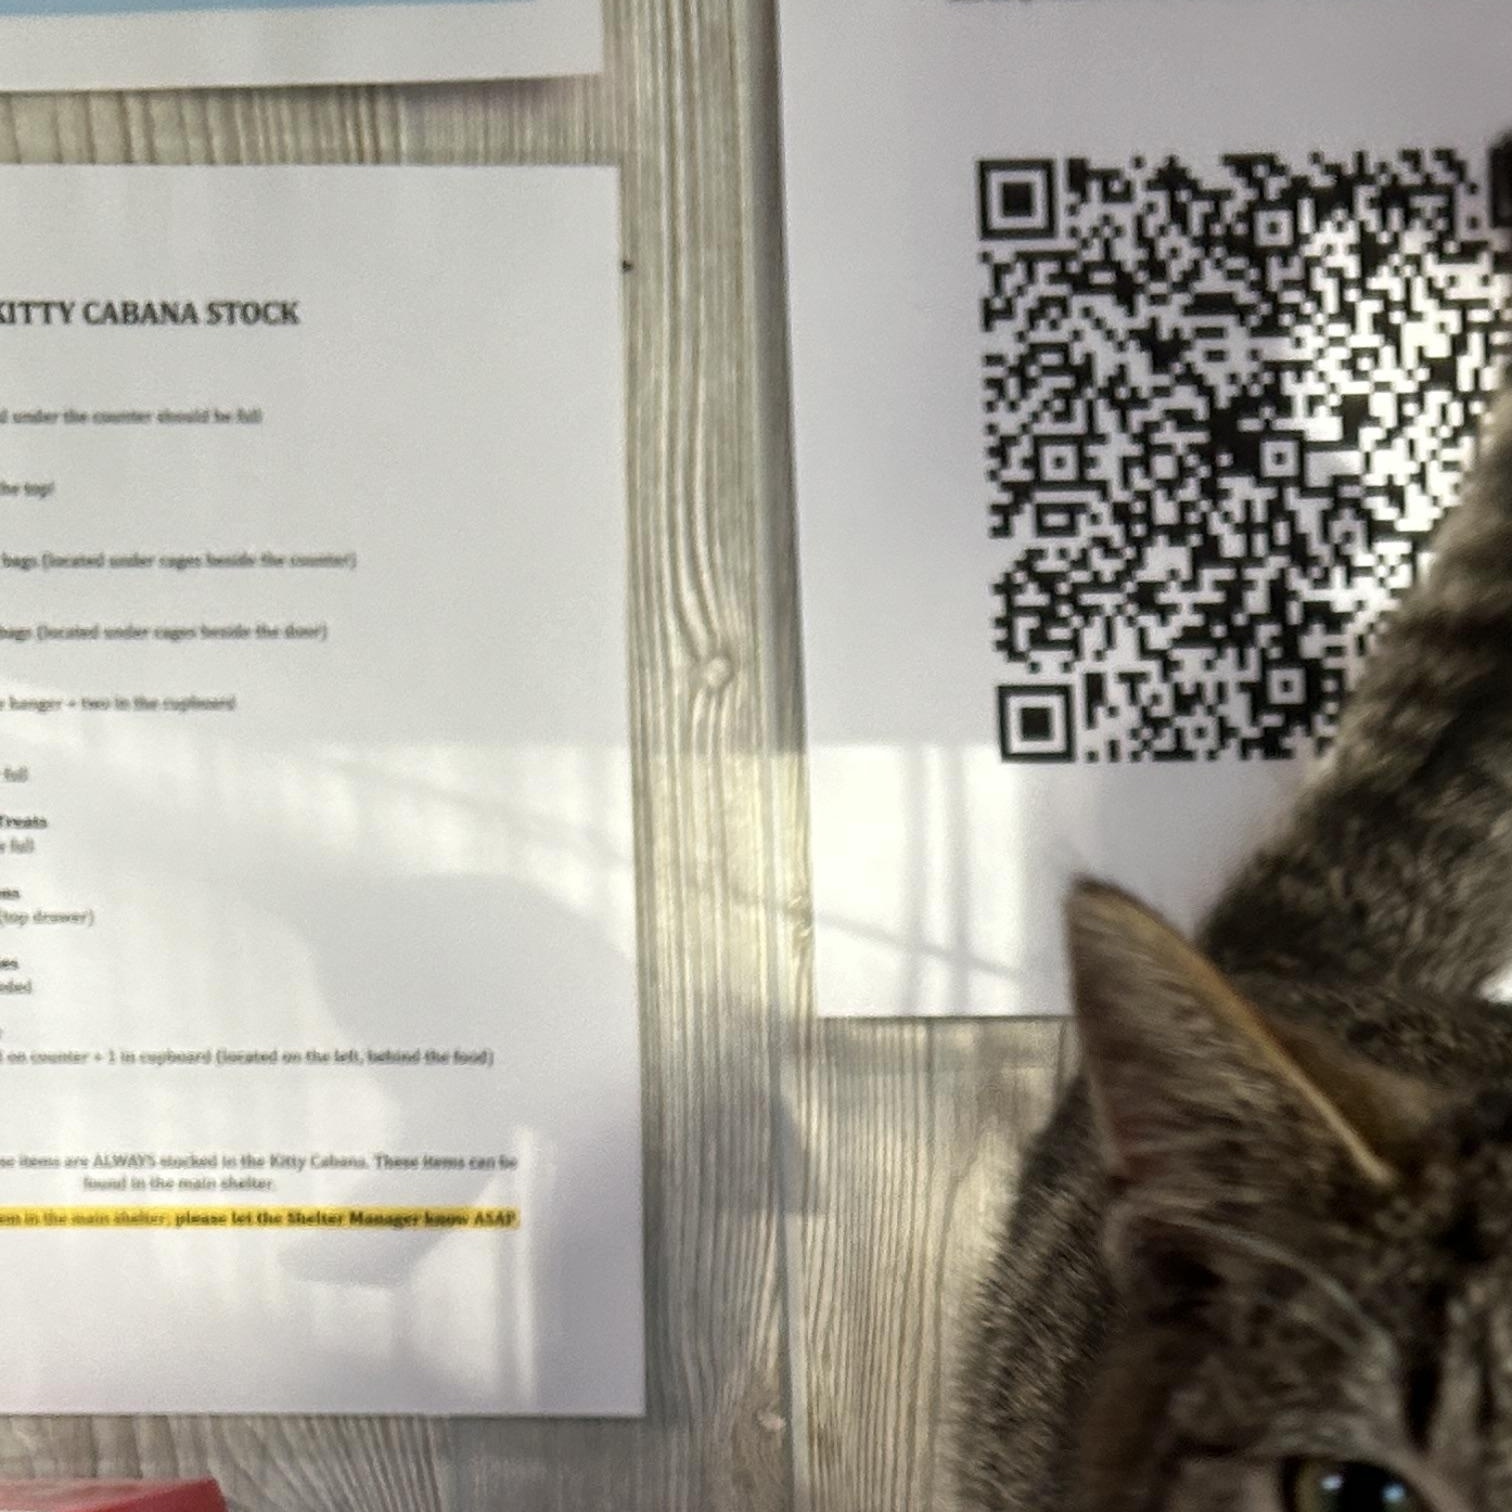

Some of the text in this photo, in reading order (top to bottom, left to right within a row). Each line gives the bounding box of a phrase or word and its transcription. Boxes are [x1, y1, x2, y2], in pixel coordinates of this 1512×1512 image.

[82, 300, 200, 325] CABANA
[206, 300, 300, 325] STOCK
[63, 409, 87, 424] the
[93, 1153, 156, 1168] ALWAYS
[240, 1153, 265, 1168] the
[269, 1153, 306, 1172] Kitty
[149, 1176, 174, 1191] the
[175, 1210, 227, 1228] please
[256, 1210, 282, 1225] the
[349, 1210, 419, 1228] Manager
